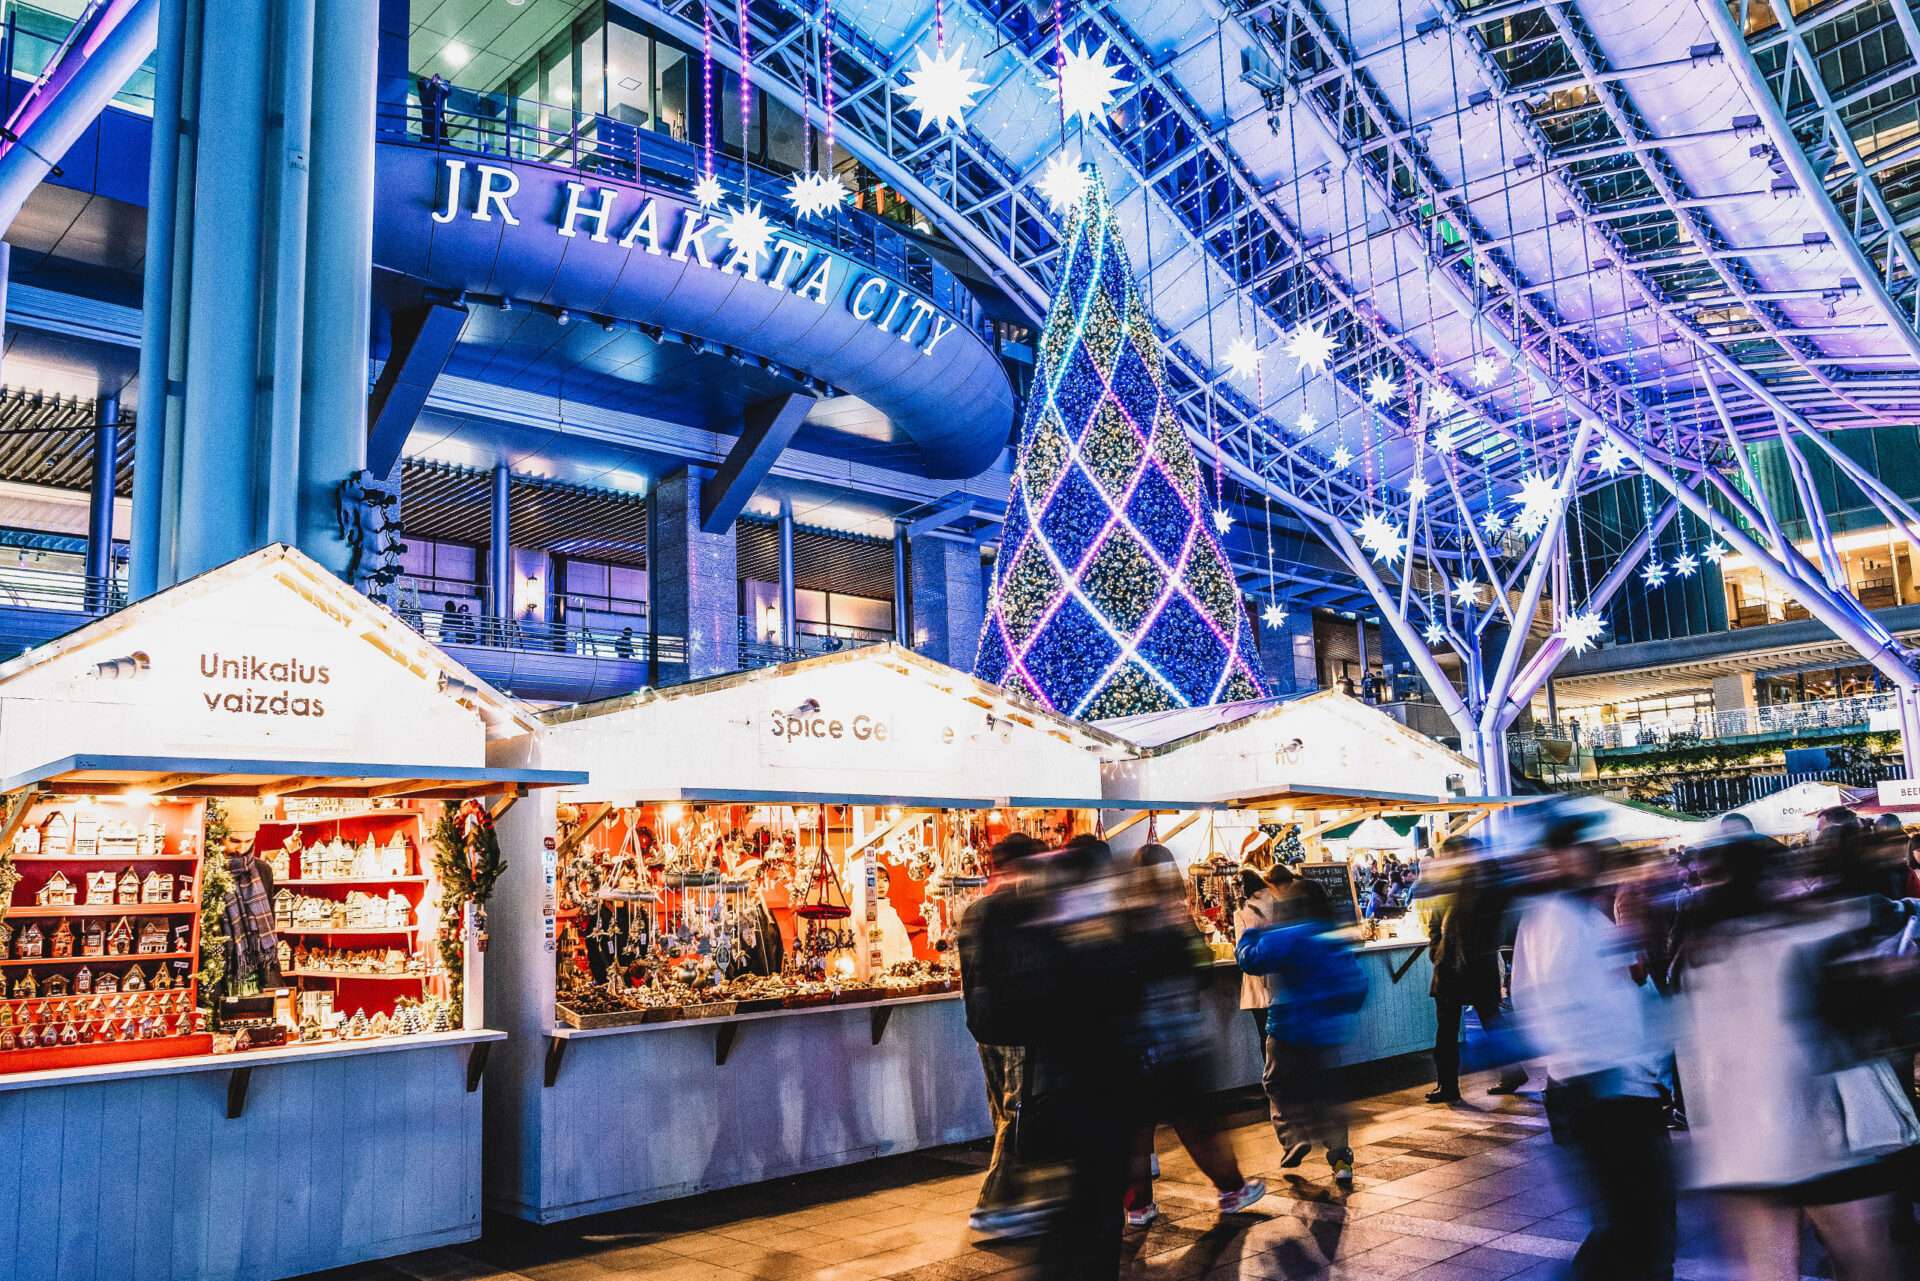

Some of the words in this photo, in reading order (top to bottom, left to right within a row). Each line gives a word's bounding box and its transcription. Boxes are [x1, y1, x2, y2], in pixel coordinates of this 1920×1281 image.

[431, 159, 520, 226] JR
[852, 277, 958, 356] CITY
[200, 652, 330, 684] Unikalus
[203, 688, 325, 717] vaizdas
[771, 709, 844, 744] Spice
